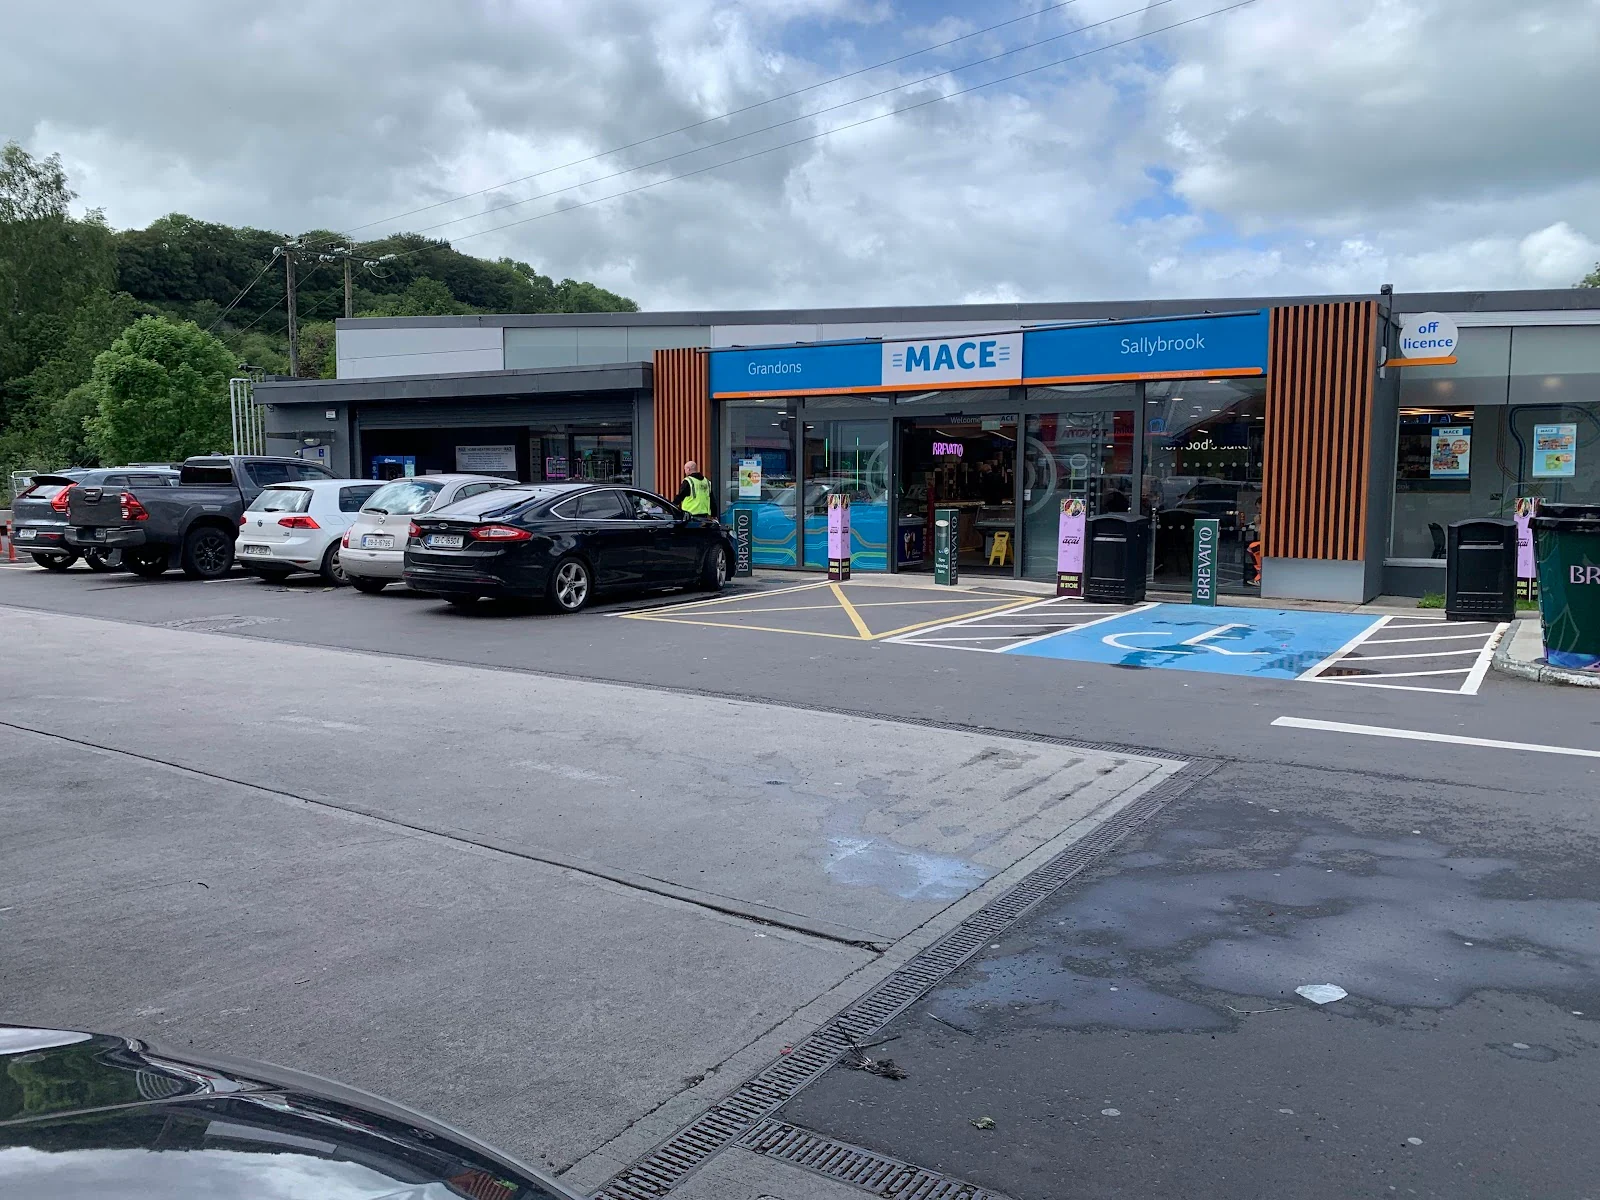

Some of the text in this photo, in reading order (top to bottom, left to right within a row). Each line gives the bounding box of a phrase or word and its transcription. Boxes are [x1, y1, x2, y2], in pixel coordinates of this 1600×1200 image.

[1418, 321, 1440, 334] off
[1120, 333, 1205, 356] Sallybrook
[1403, 338, 1453, 349] licence
[748, 361, 802, 375] Grandons
[905, 341, 997, 372] MACE
[737, 514, 749, 572] BREVATO
[1197, 526, 1213, 599] BREVATO
